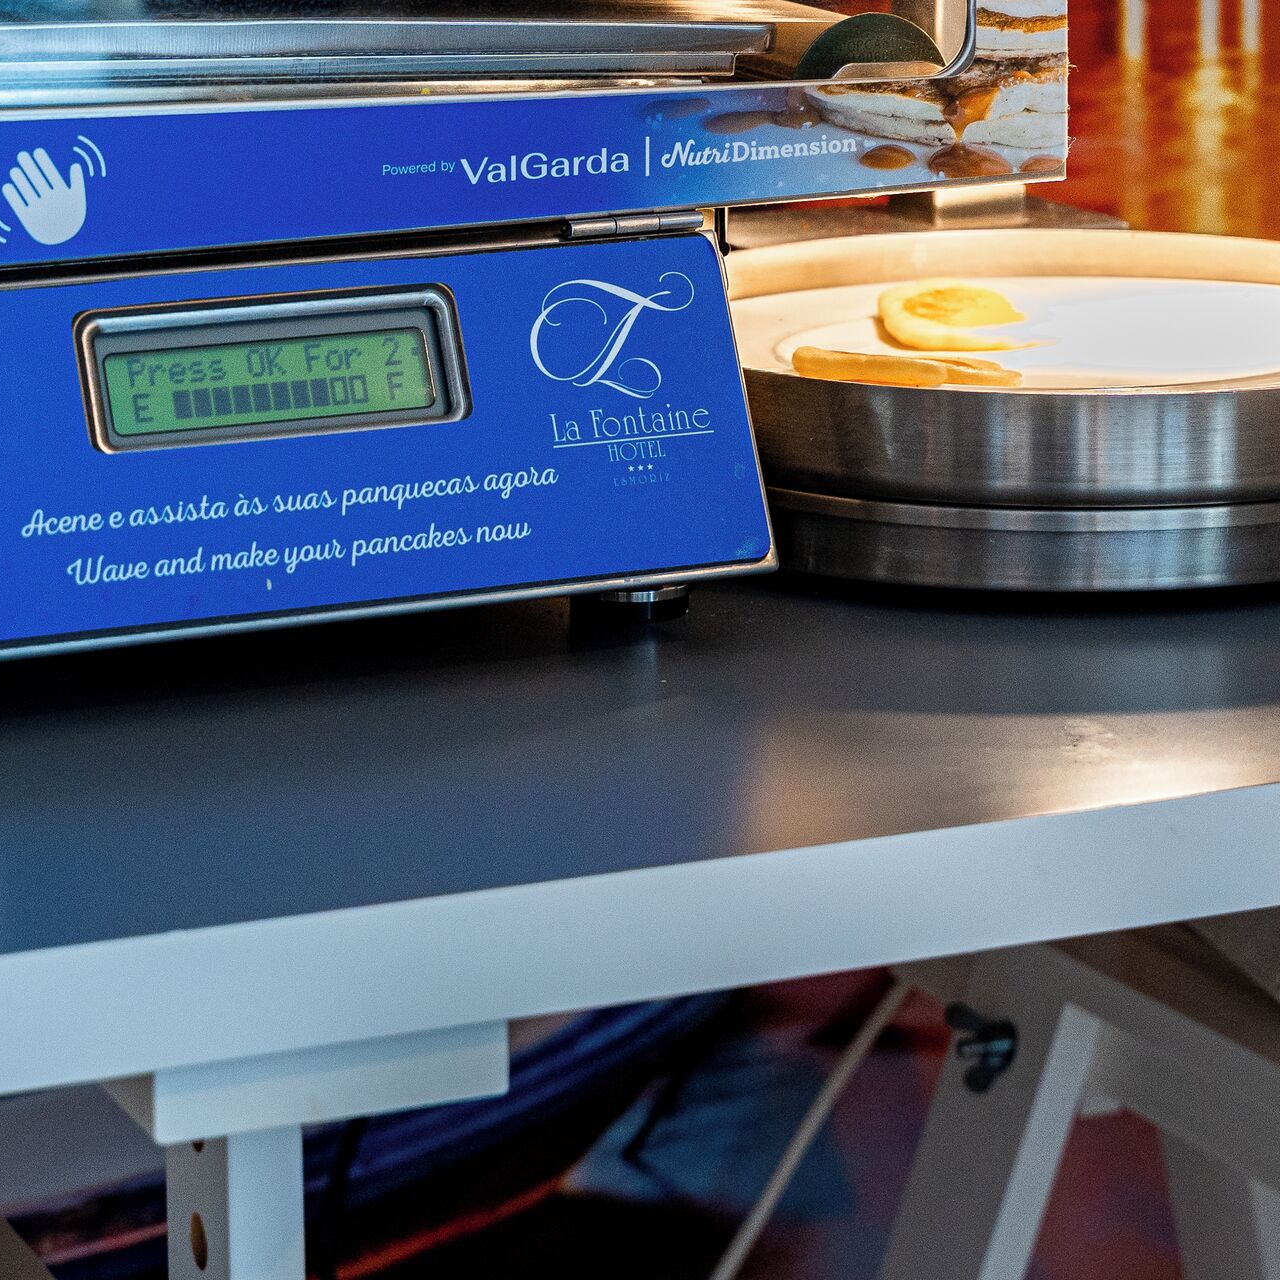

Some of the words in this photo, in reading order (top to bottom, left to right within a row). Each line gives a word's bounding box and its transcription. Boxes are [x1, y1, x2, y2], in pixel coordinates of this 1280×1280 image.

[382, 161, 436, 175] Powered
[441, 160, 455, 173] by
[460, 148, 629, 185] ValGarda
[661, 135, 857, 168] NutriDimension
[126, 355, 226, 388] Press
[245, 346, 287, 378] OK
[304, 342, 362, 372] For
[383, 336, 402, 366] 2
[131, 393, 154, 423] E
[387, 371, 404, 400] F
[550, 413, 581, 442] La
[589, 404, 710, 438] Fontaine
[608, 440, 666, 461] HOTEL
[22, 509, 104, 537] Acene
[109, 511, 125, 528] e
[129, 494, 228, 527] assista
[234, 494, 268, 516] às
[273, 490, 337, 513] suas
[341, 475, 479, 516] panquecas
[484, 467, 559, 499] agora
[67, 555, 150, 585] Wave
[154, 547, 205, 577] and
[211, 541, 280, 571] make
[284, 539, 346, 573] your
[351, 523, 472, 566] pancakes
[476, 521, 531, 544] now
